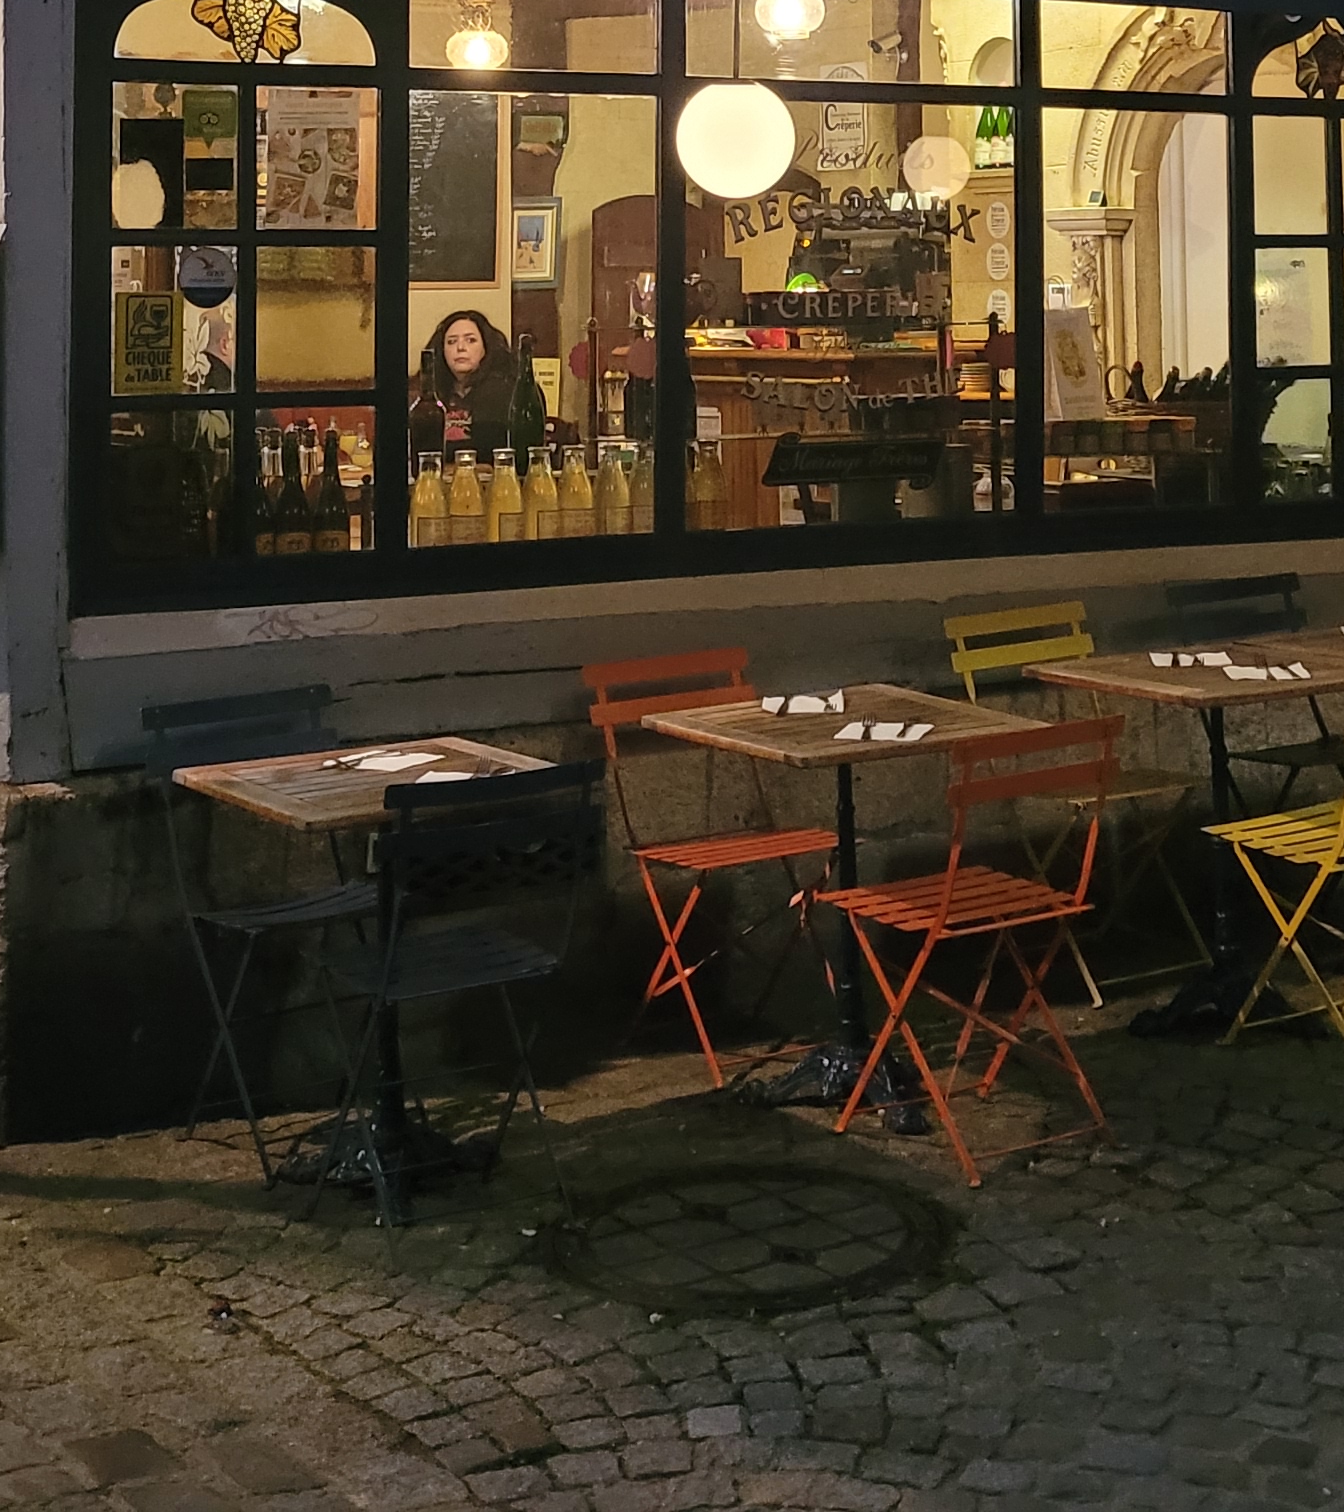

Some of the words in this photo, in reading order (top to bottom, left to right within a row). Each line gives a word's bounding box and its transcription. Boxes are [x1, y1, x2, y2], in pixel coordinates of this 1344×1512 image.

[135, 367, 173, 383] TABLE
[740, 370, 862, 412] SALON
[868, 389, 894, 408] de
